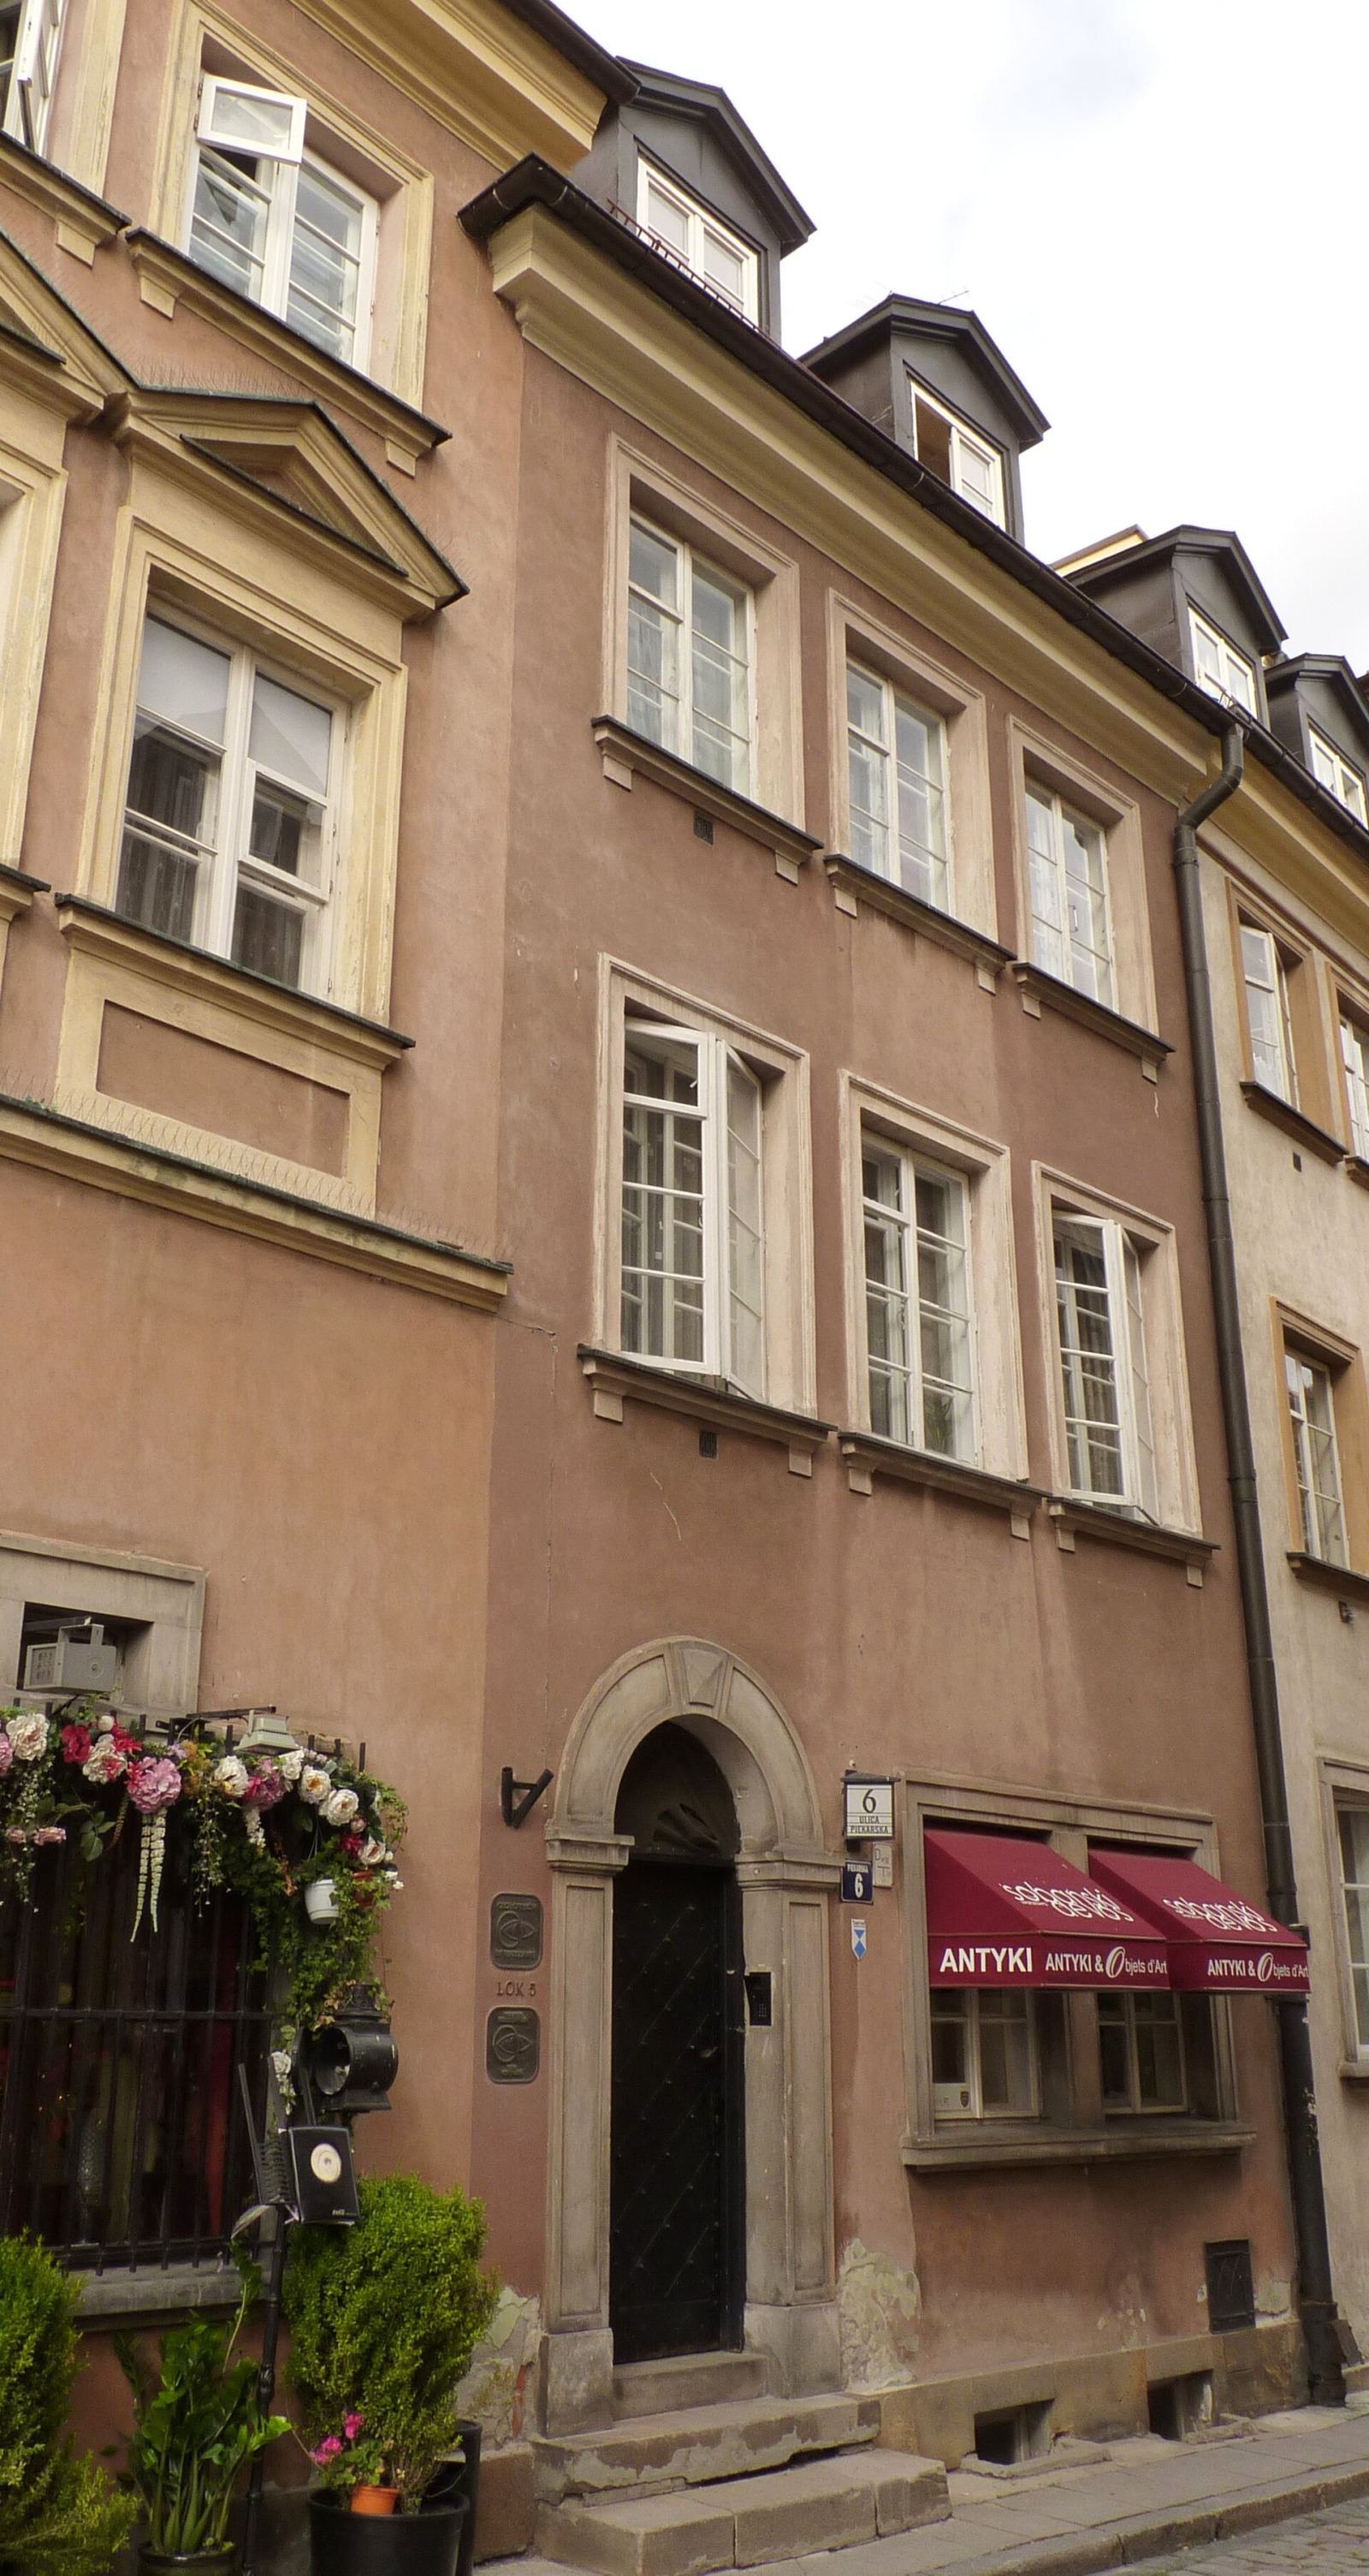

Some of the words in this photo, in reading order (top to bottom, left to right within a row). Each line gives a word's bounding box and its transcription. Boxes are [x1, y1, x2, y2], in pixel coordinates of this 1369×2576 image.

[862, 1789, 876, 1813] 6
[850, 1825, 889, 1834] PIEKARSKA
[859, 1815, 880, 1824] ULICA
[855, 1873, 864, 1898] 6
[939, 1947, 1033, 1973] ANTYKI
[1046, 1953, 1092, 1972] ANTYKI
[1094, 1955, 1105, 1973] &
[1105, 1946, 1146, 1979] Objets
[1147, 1958, 1168, 1974] d'Art
[1207, 1959, 1247, 1976] ANTYKI
[1248, 1960, 1256, 1977] &
[1257, 1952, 1290, 1982] Objets
[497, 1981, 524, 1997] LOK
